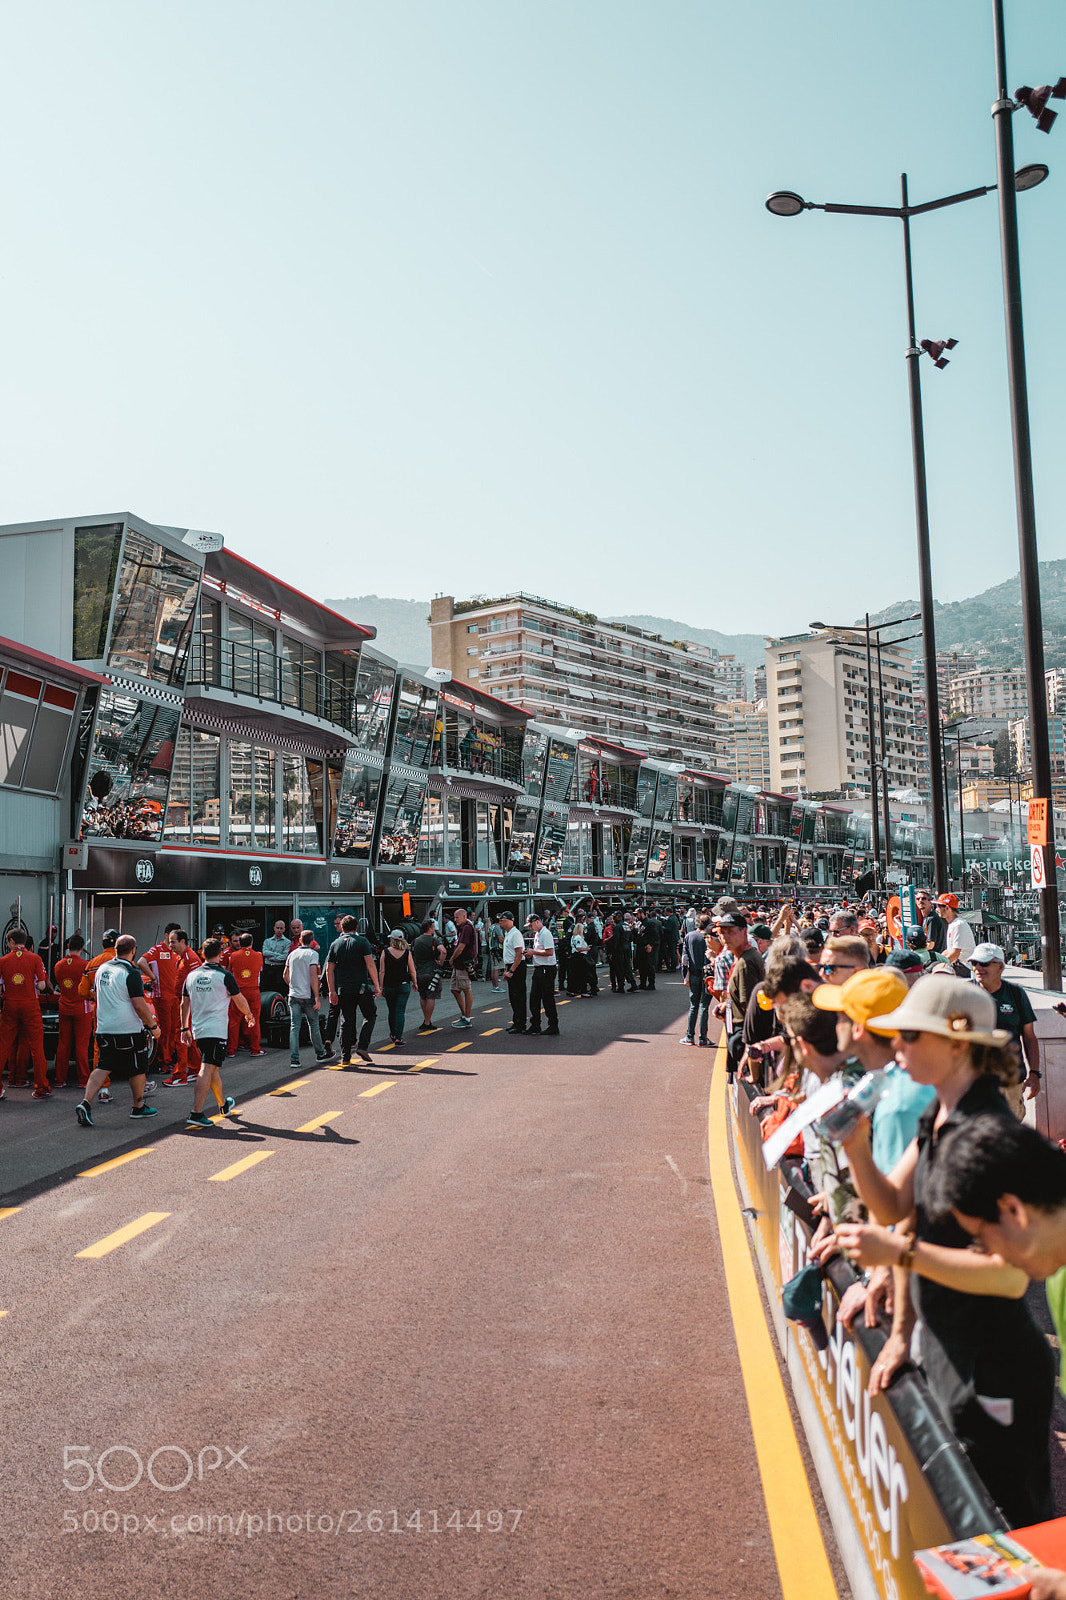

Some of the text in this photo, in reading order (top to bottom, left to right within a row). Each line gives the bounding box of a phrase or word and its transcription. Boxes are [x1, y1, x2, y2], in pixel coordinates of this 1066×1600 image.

[136, 863, 153, 879] FIA
[964, 857, 1031, 873] Heineke
[249, 868, 262, 883] FIA
